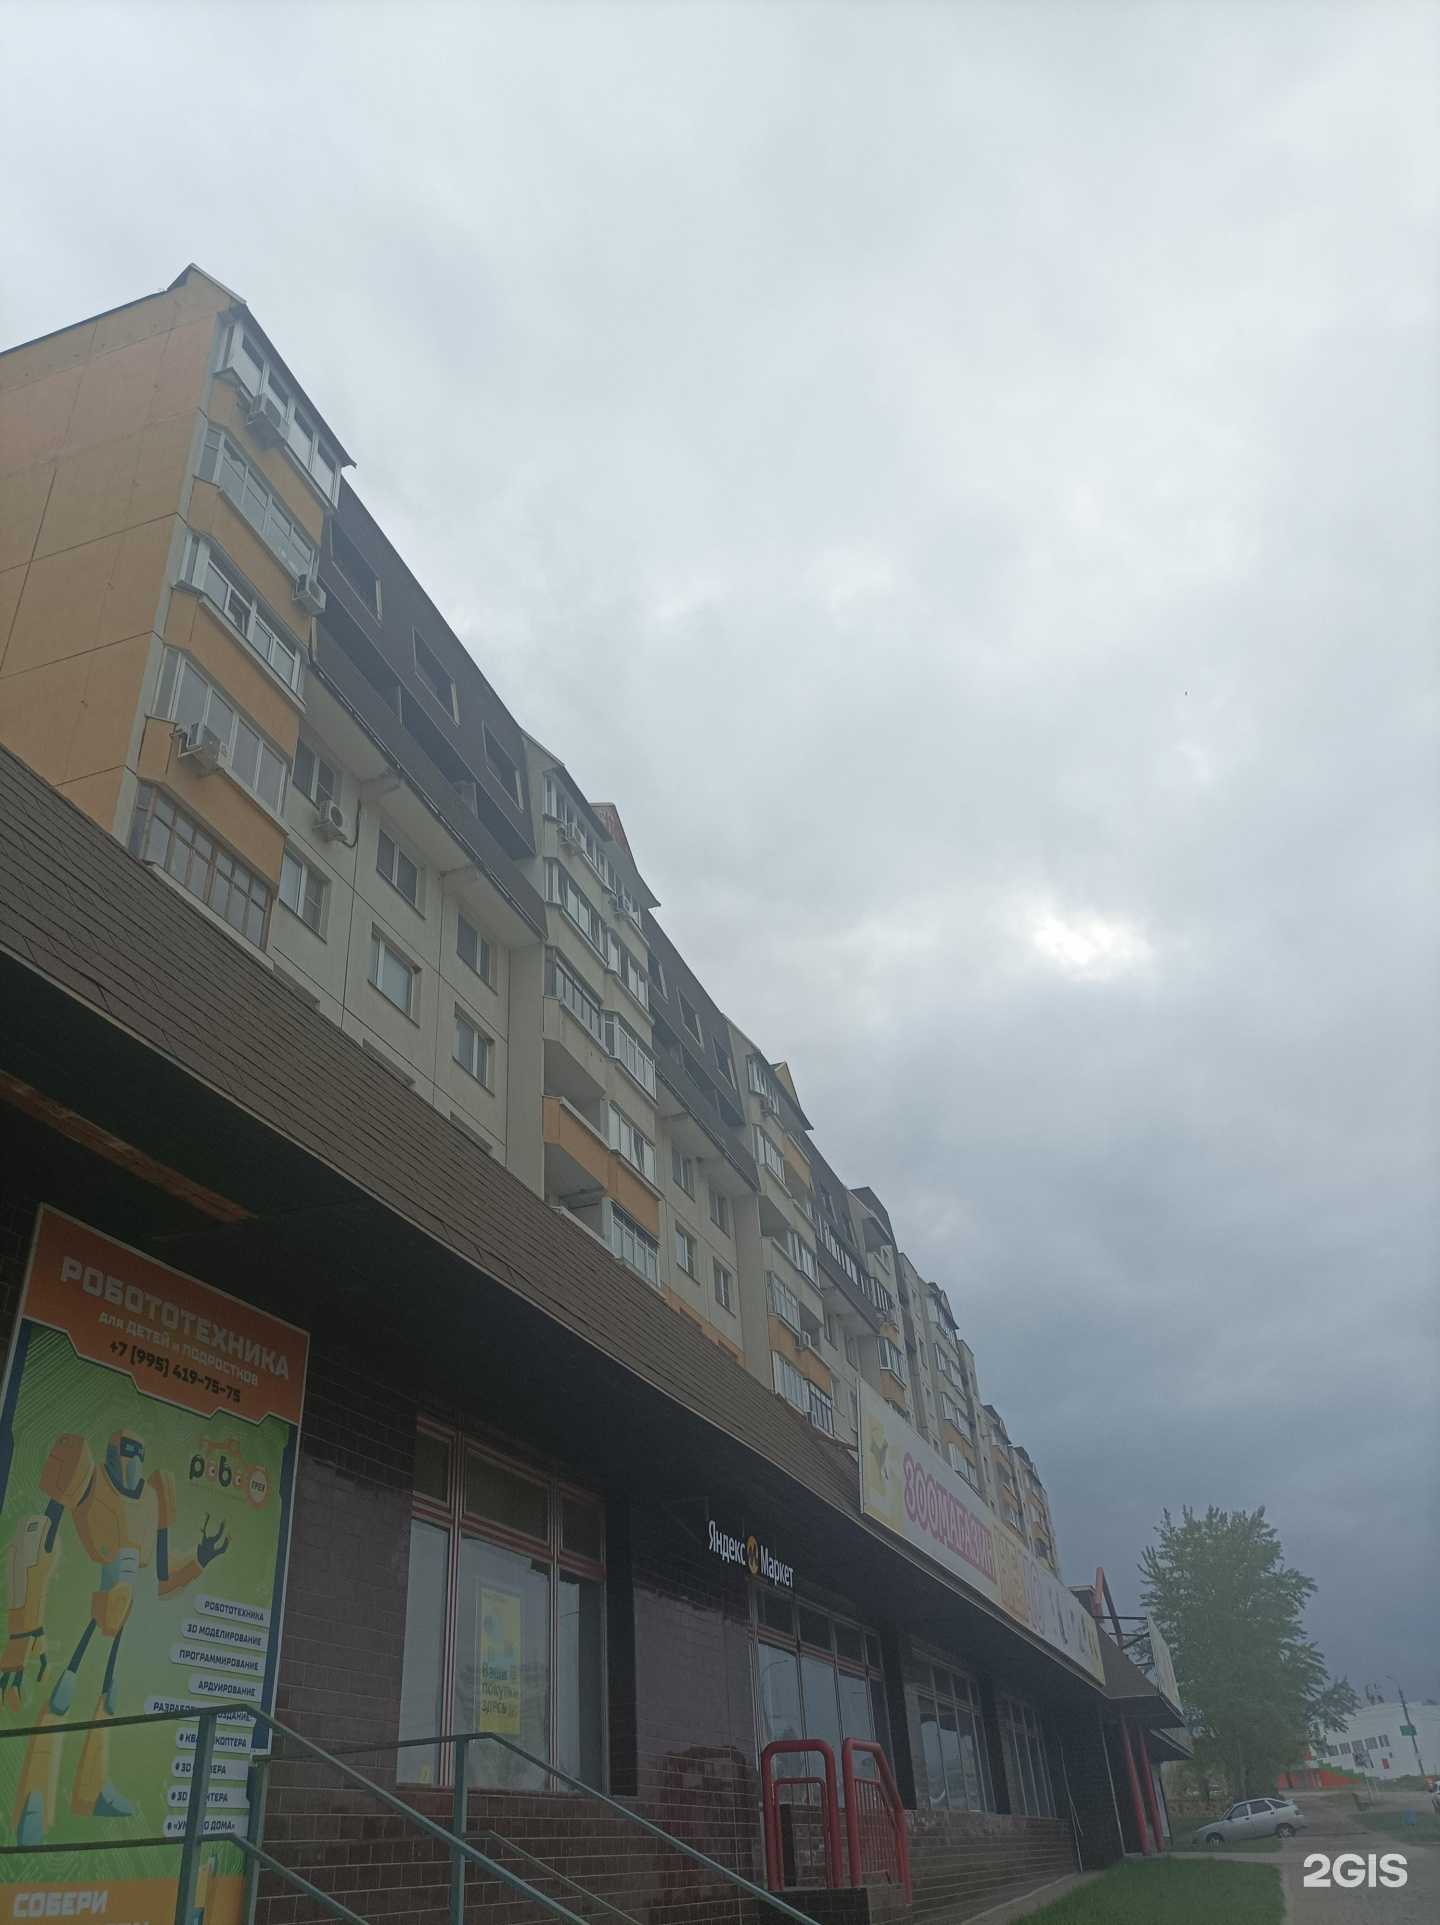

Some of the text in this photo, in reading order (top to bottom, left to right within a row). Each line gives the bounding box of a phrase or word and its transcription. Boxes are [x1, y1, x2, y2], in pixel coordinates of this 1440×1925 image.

[61, 1256, 289, 1379] РОБОТОТЕХНИКА
[127, 1319, 170, 1346] ДЕТЕЙ
[181, 1343, 258, 1386] ПОДРОСТКОВ
[110, 1341, 129, 1357] +7
[172, 1365, 241, 1402] 419-75-75
[708, 1520, 793, 1588] Яндекс Маркет
[204, 1600, 264, 1621] РОБОТОТЕХНИКА
[187, 1623, 261, 1646] 3D МОДЕЛИРОВАНИЕ
[179, 1649, 259, 1671] ПРОГРАММИРОВАНИЕ
[198, 1681, 256, 1697] АРДУИРОВАНИЕ
[13, 1889, 108, 1918] СОБЕРИ
